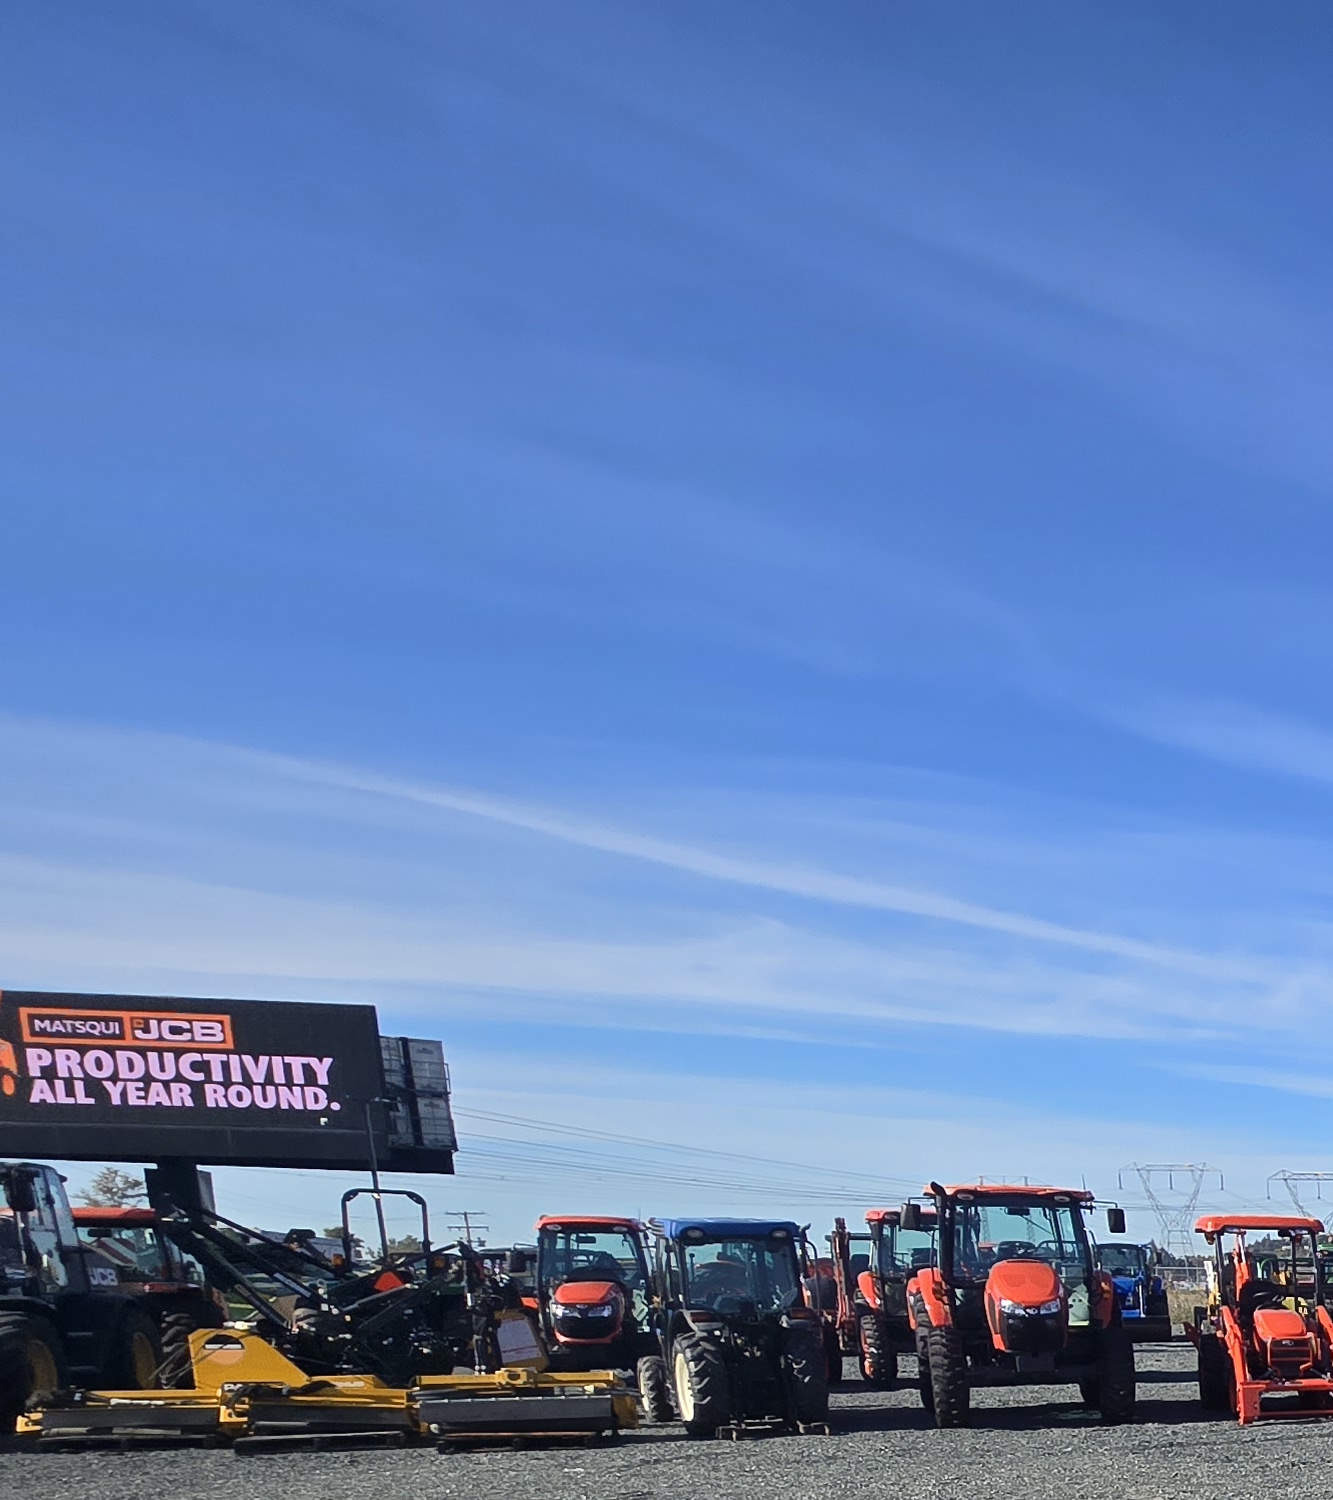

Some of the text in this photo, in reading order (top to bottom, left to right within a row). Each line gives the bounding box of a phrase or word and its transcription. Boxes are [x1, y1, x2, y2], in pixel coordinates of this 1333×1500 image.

[34, 1018, 224, 1042] MATSQUI JCB
[25, 1048, 333, 1085] PRODUCTIVITY
[29, 1079, 341, 1111] ALL YEAR ROUND.
[90, 1267, 119, 1286] JCB
